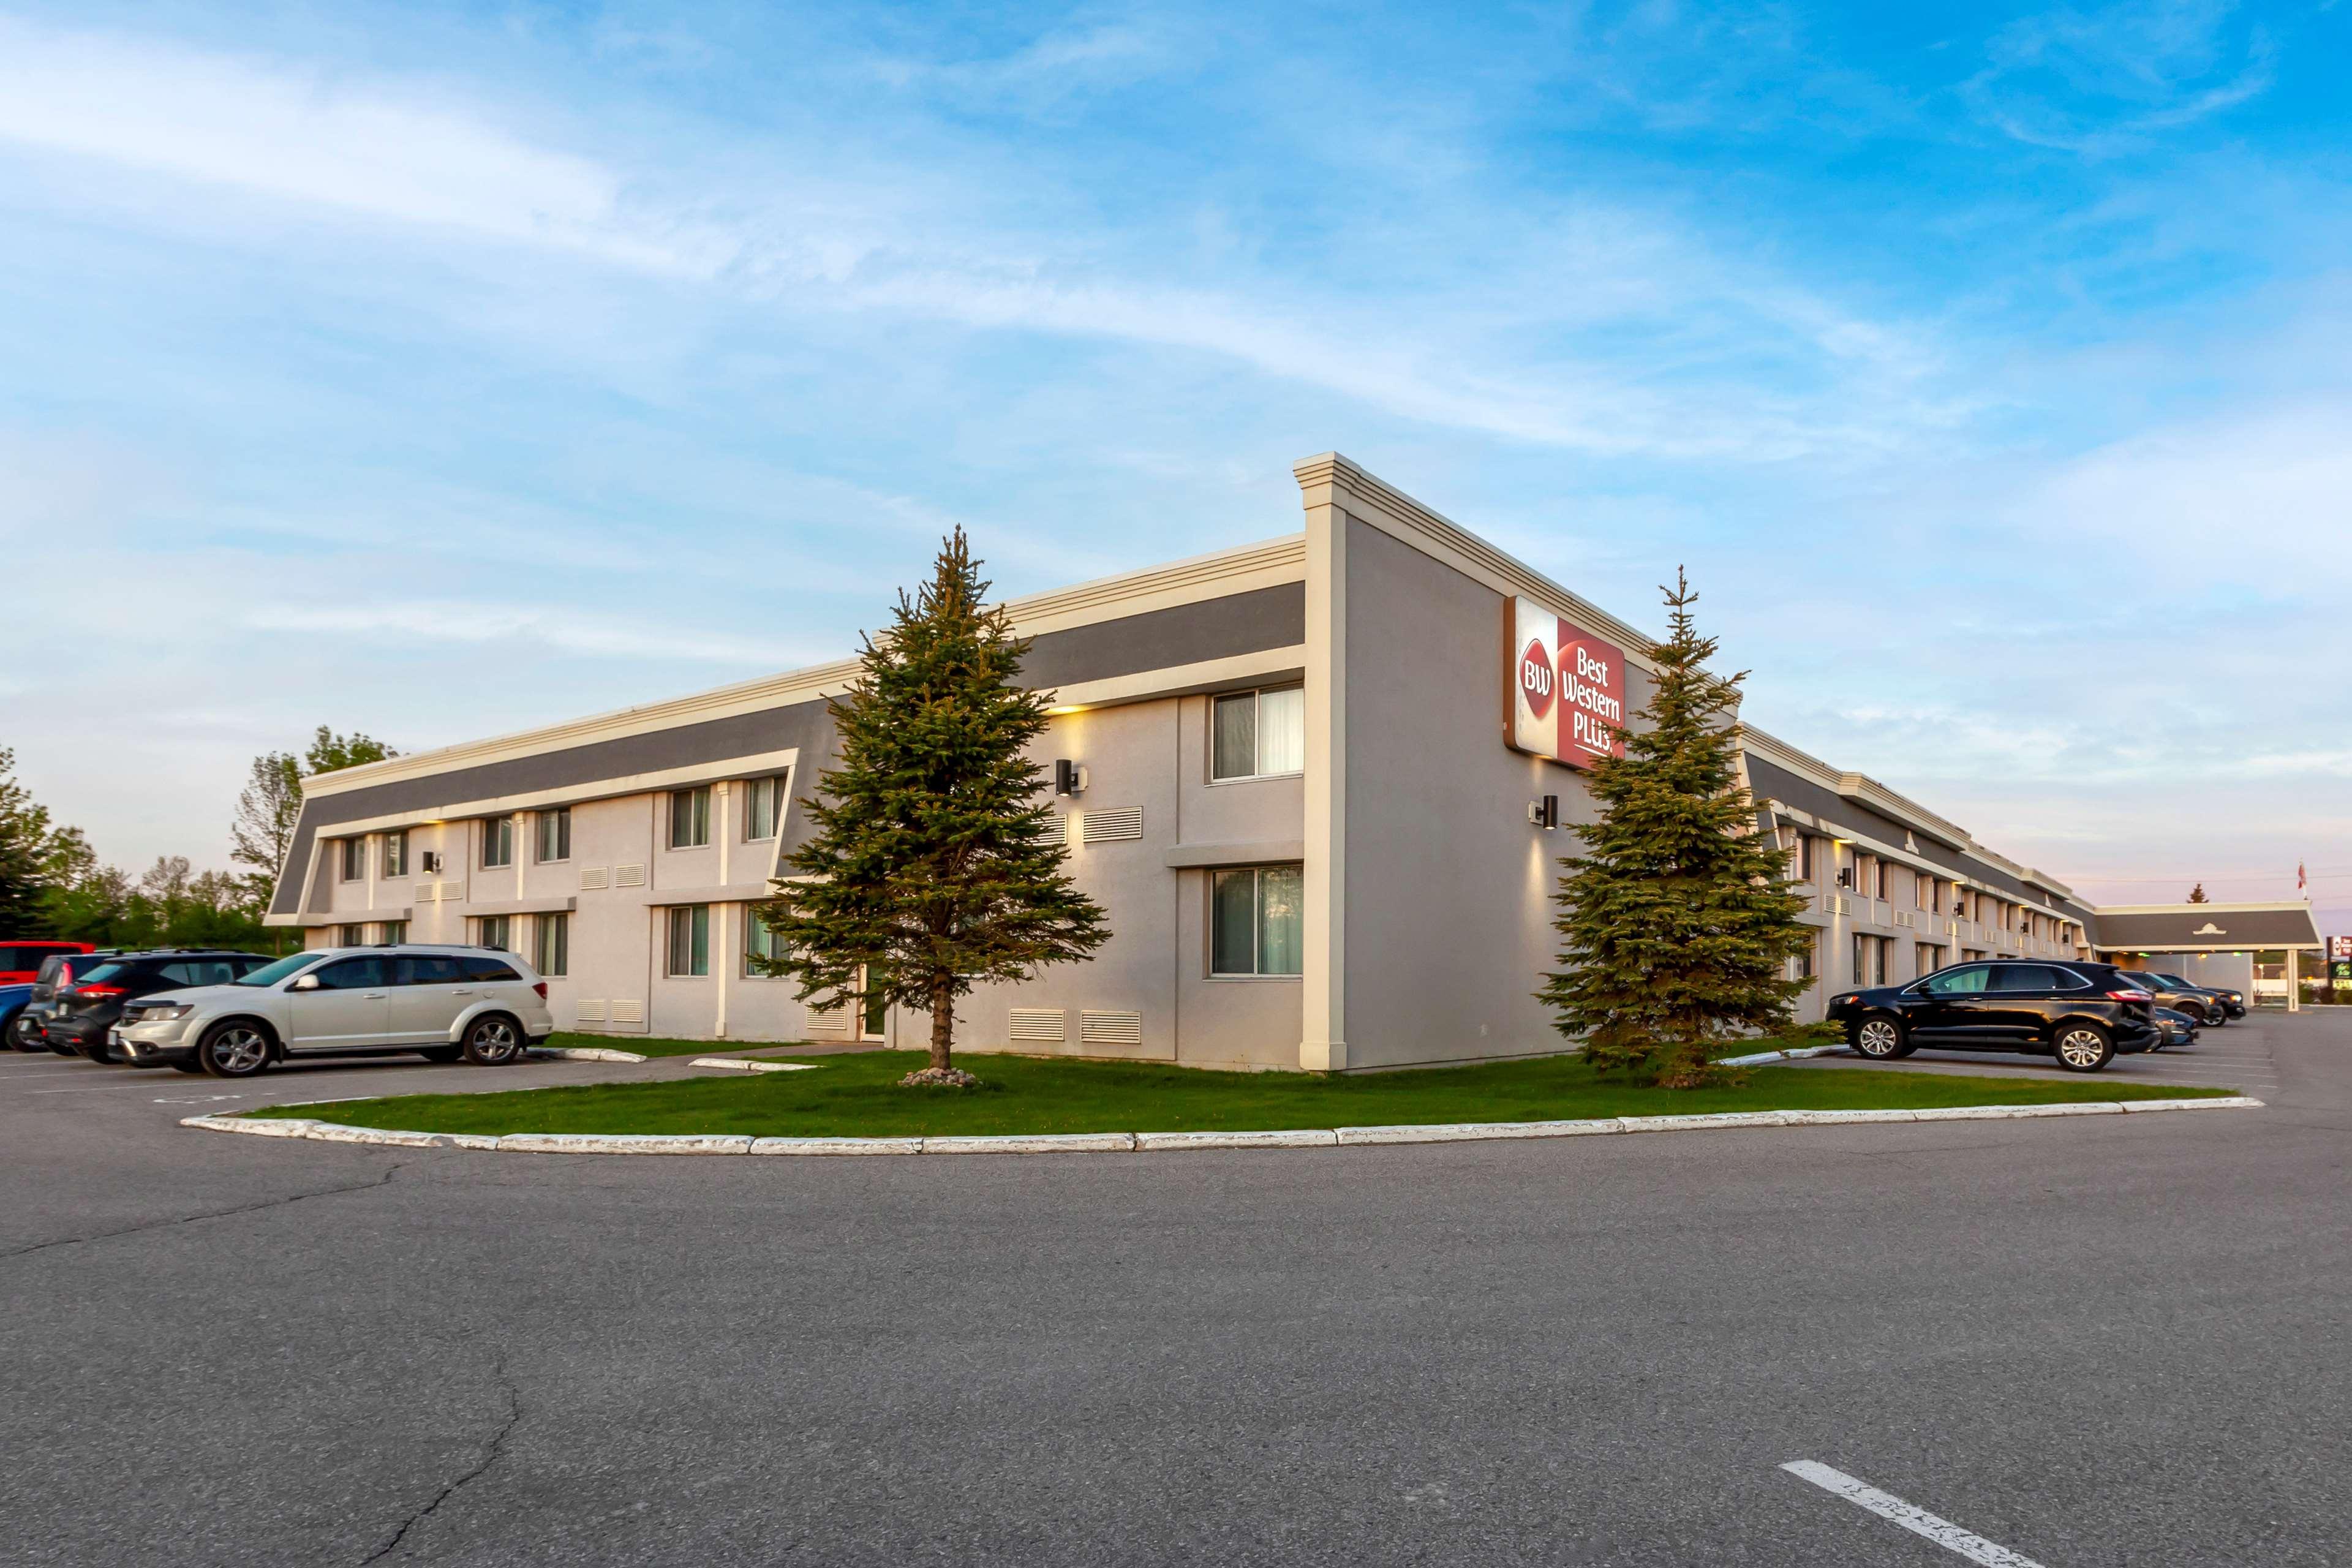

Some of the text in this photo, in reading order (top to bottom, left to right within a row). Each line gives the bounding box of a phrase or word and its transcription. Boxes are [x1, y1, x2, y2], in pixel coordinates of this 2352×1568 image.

[1525, 660, 1551, 696] BW
[1577, 646, 1608, 687] Best
[1562, 670, 1621, 722] Western
